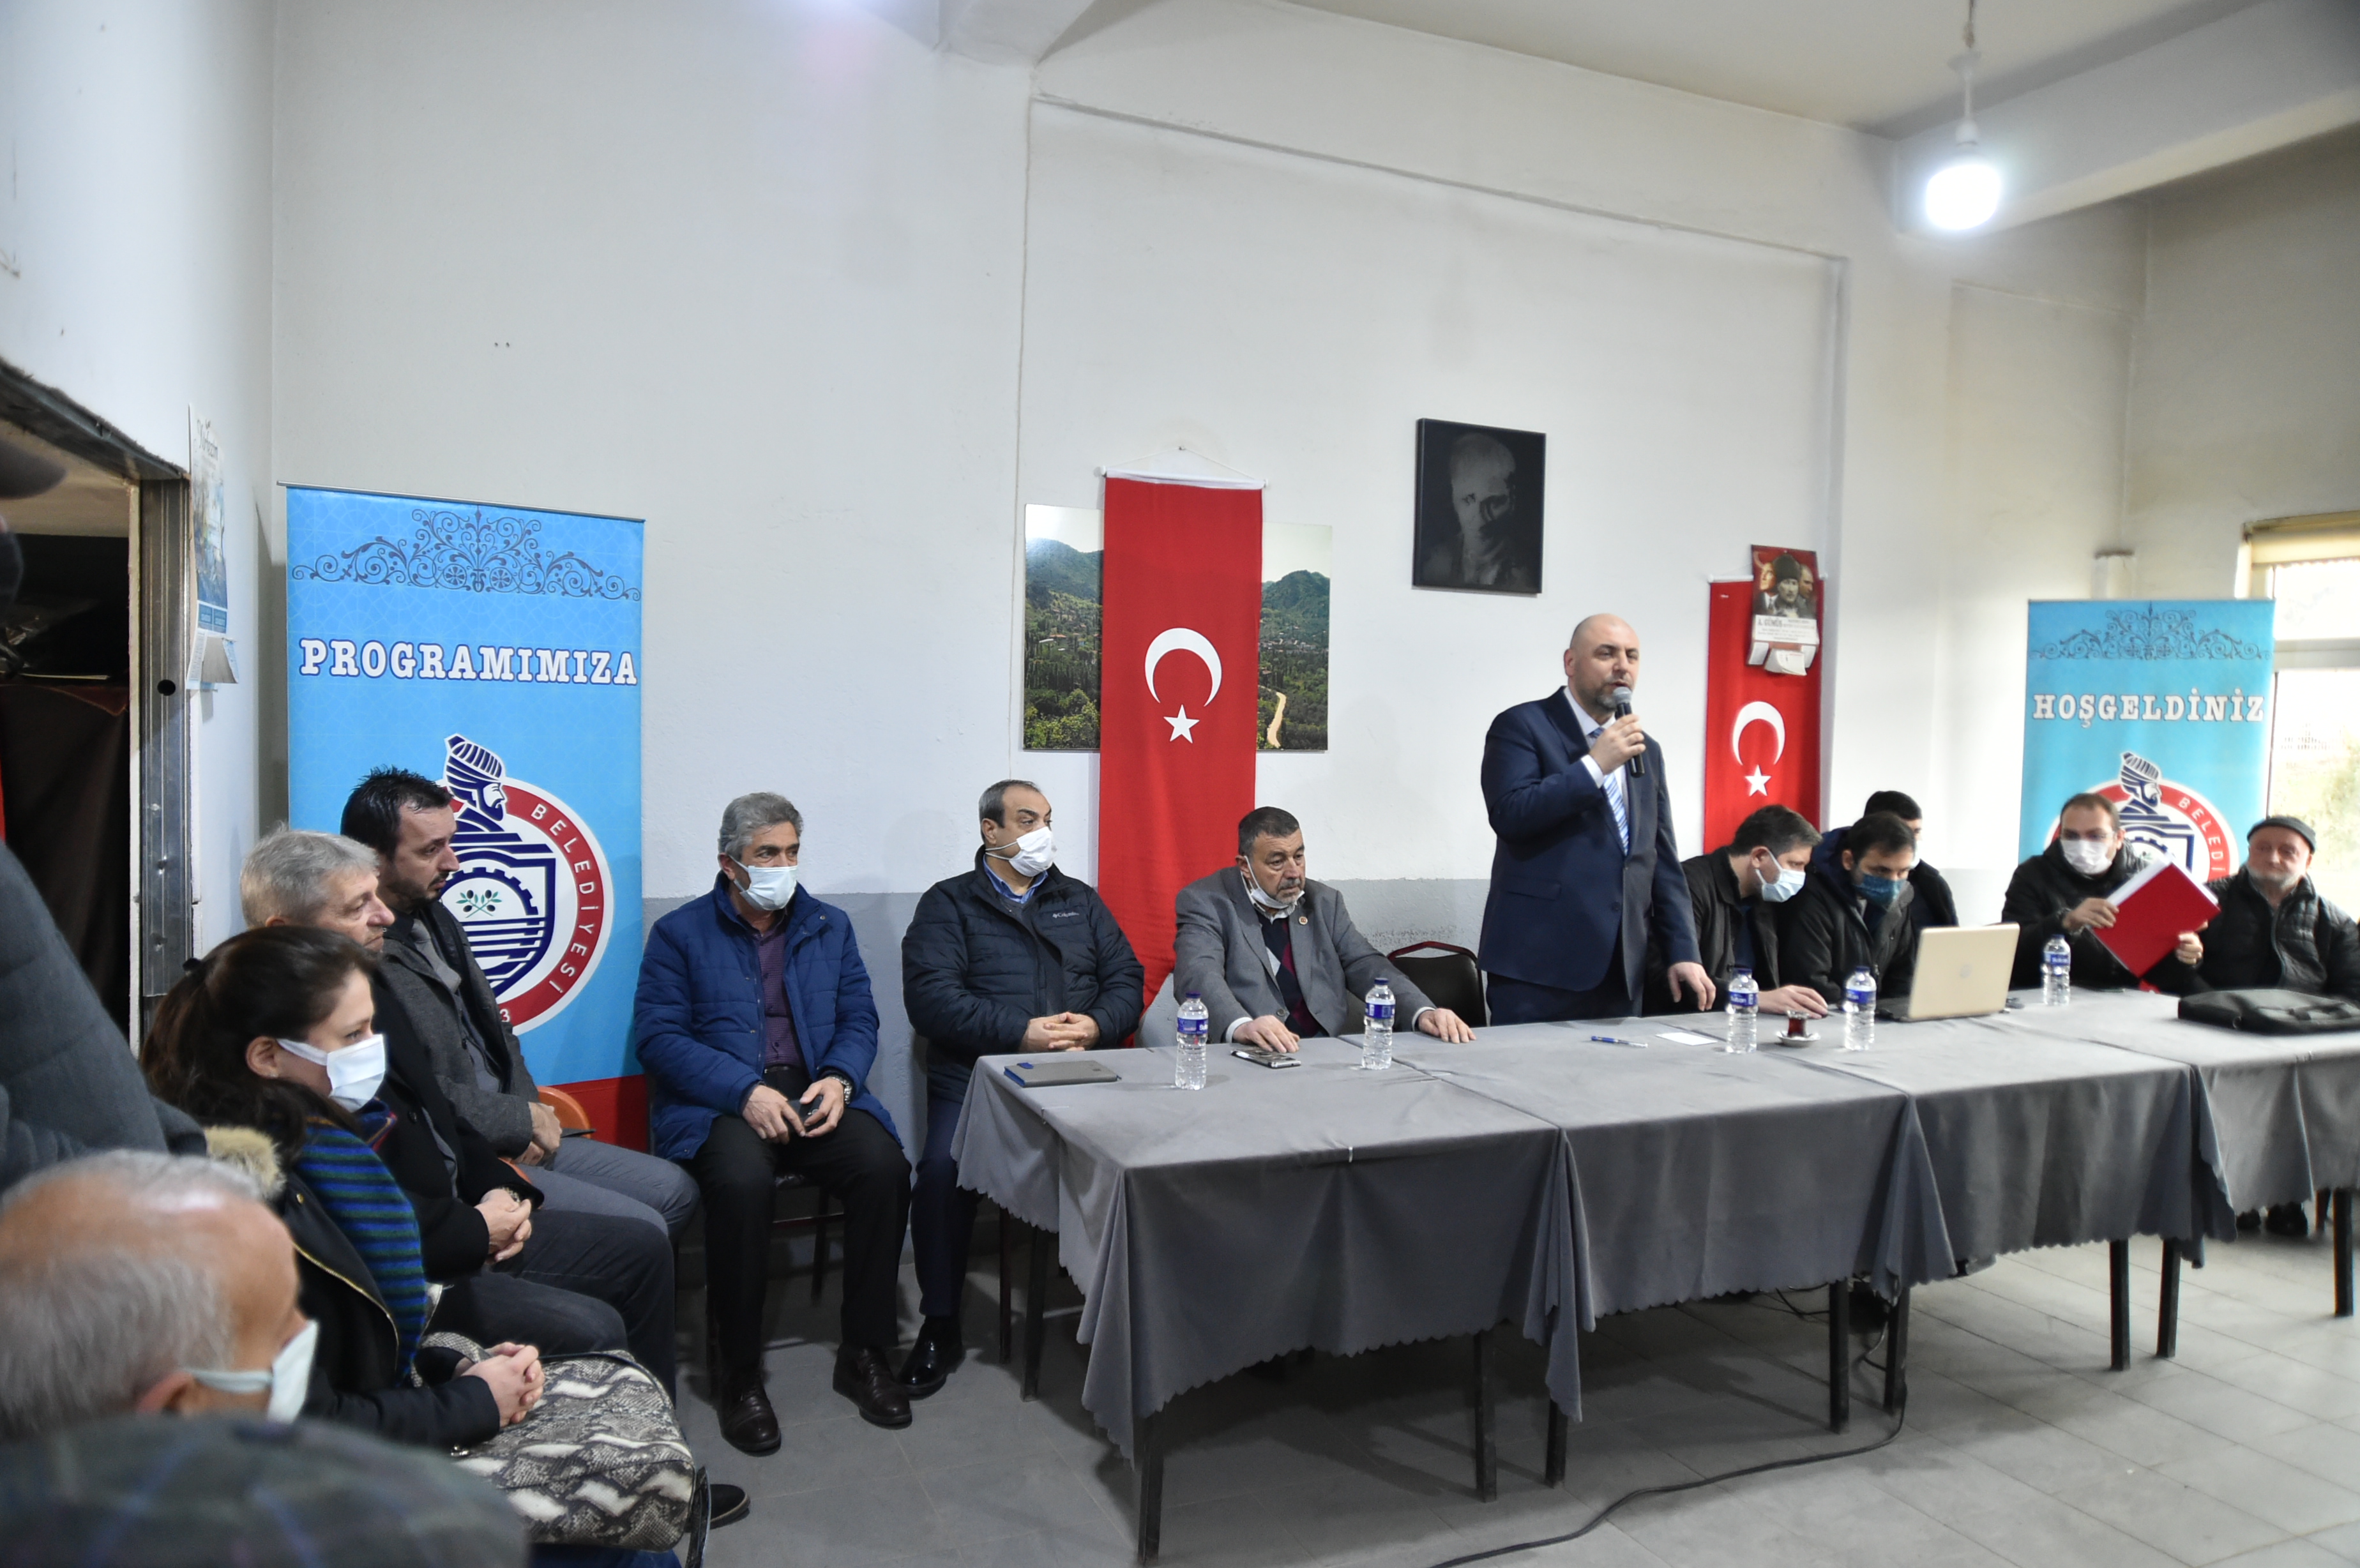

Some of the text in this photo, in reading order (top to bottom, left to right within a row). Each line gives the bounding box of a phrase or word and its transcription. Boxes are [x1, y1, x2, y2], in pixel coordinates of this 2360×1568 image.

[299, 638, 637, 686] PROGRAMIMIZA
[2033, 687, 2264, 729] HOŞGELDİNİZ
[2178, 797, 2227, 871] BELEDİ
[531, 803, 598, 993] BELEDİYESİ
